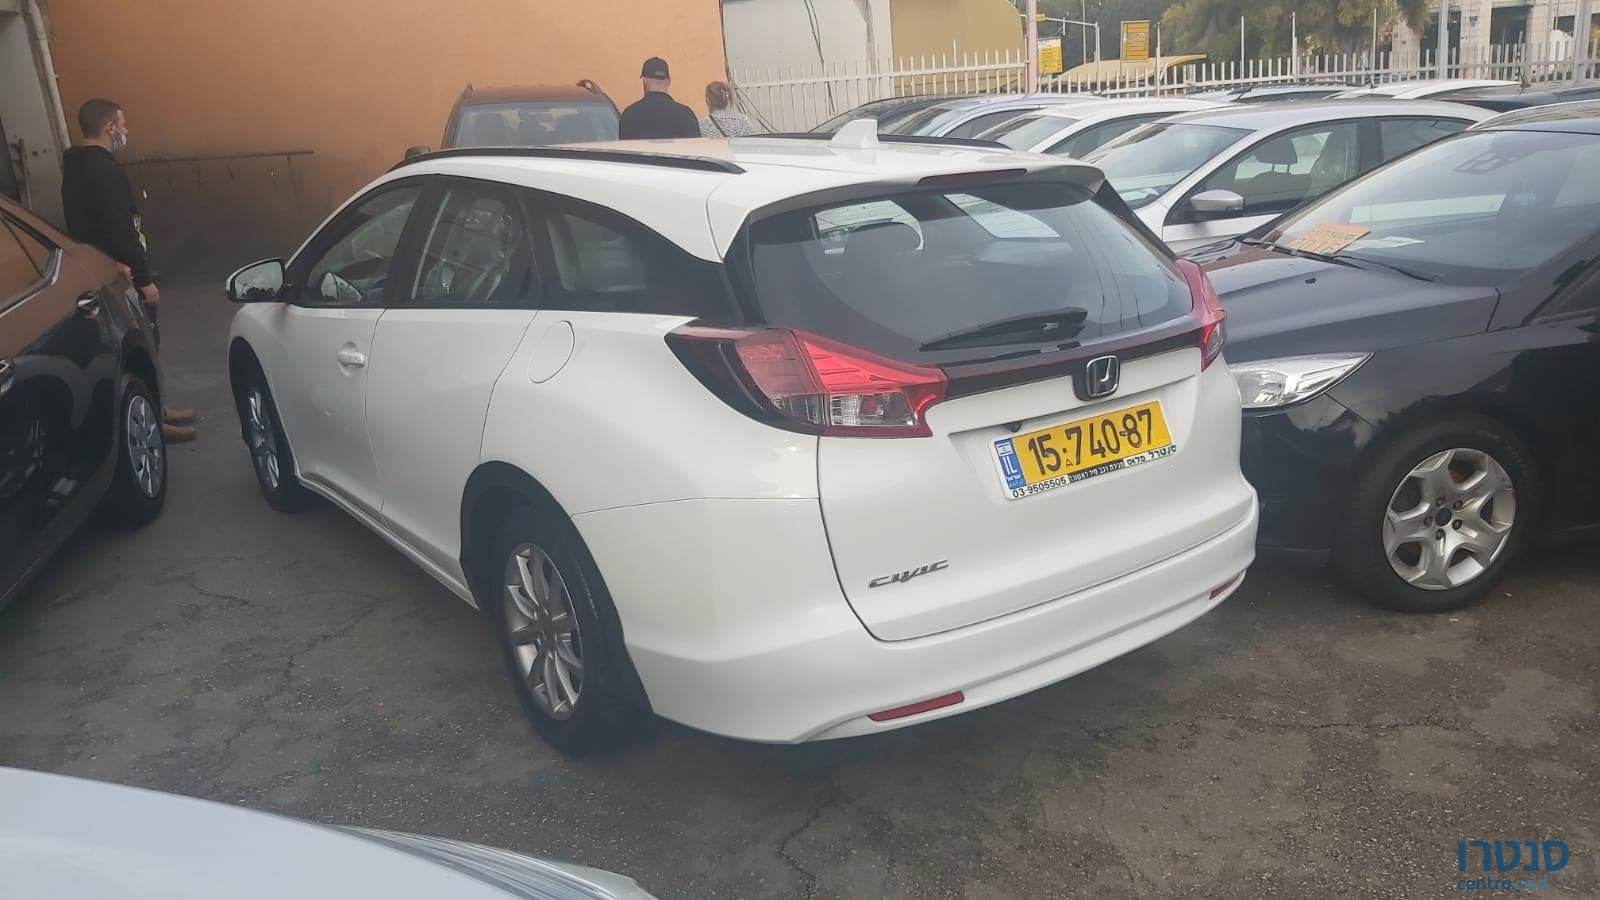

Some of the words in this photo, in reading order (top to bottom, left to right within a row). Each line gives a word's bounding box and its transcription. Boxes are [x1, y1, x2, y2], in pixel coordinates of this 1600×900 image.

[1148, 444, 1177, 459] סנטרל
[1003, 455, 1018, 475] IL
[1126, 456, 1146, 466] פלוס
[869, 559, 949, 588] CIVIC
